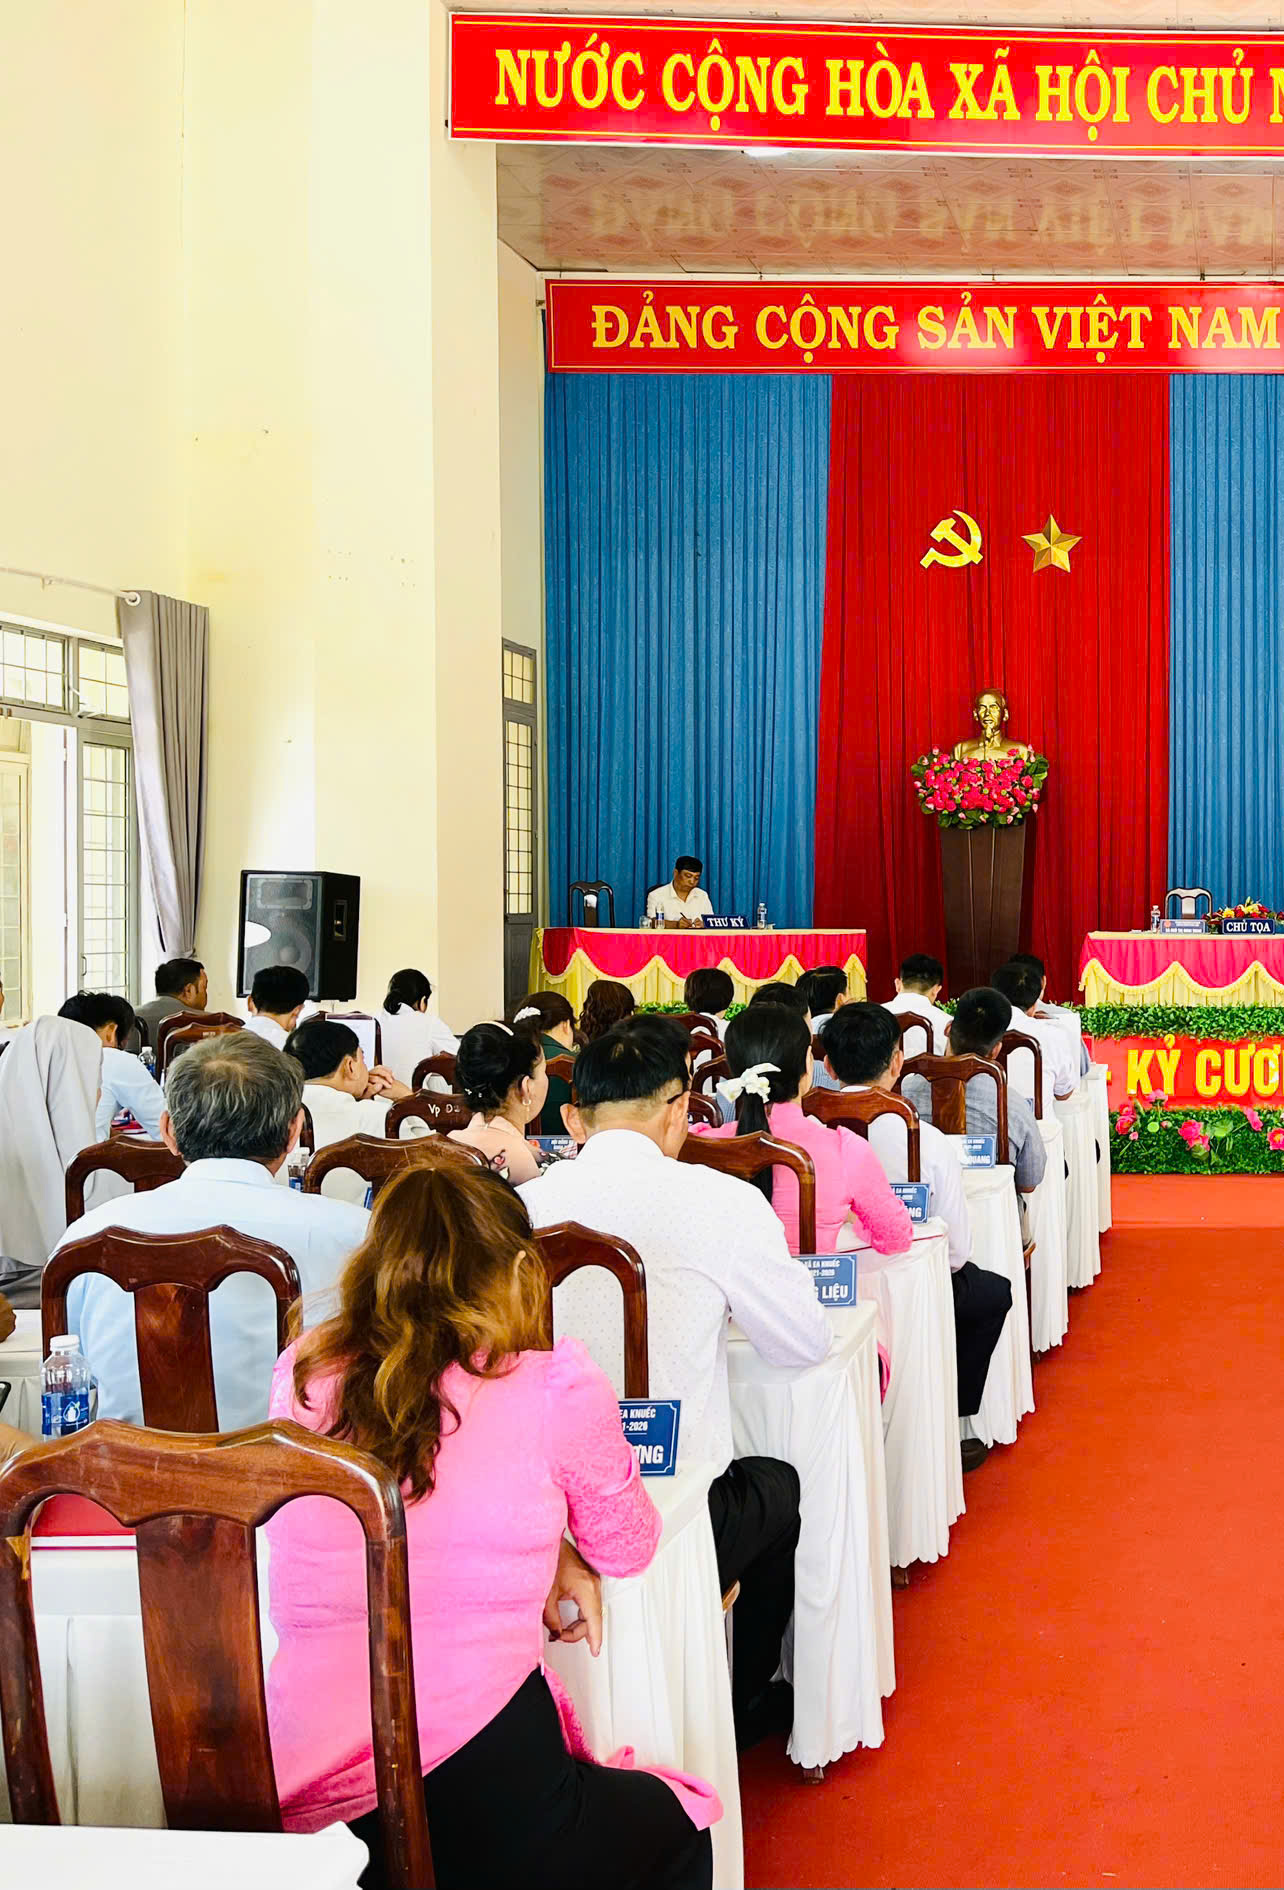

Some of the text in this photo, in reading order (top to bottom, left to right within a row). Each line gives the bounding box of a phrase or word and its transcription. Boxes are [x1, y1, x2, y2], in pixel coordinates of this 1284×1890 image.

[495, 33, 645, 111] NƯỚC
[662, 38, 809, 132] CỘNG
[825, 42, 933, 121] HÒA
[949, 47, 1021, 121] XÃ
[1036, 49, 1131, 142] HỘI
[1146, 48, 1254, 125] CHỦ
[591, 290, 737, 350] ĐẢNG
[756, 293, 901, 364] CỘNG
[917, 290, 1019, 350] SẢN
[1031, 293, 1153, 364] VIỆT
[1167, 304, 1281, 350] NAM
[706, 916, 729, 927] THƯ
[1226, 919, 1271, 934] CHỦ TỌA
[1127, 1034, 1182, 1096] KỶ
[822, 1282, 849, 1302] LIỆU
